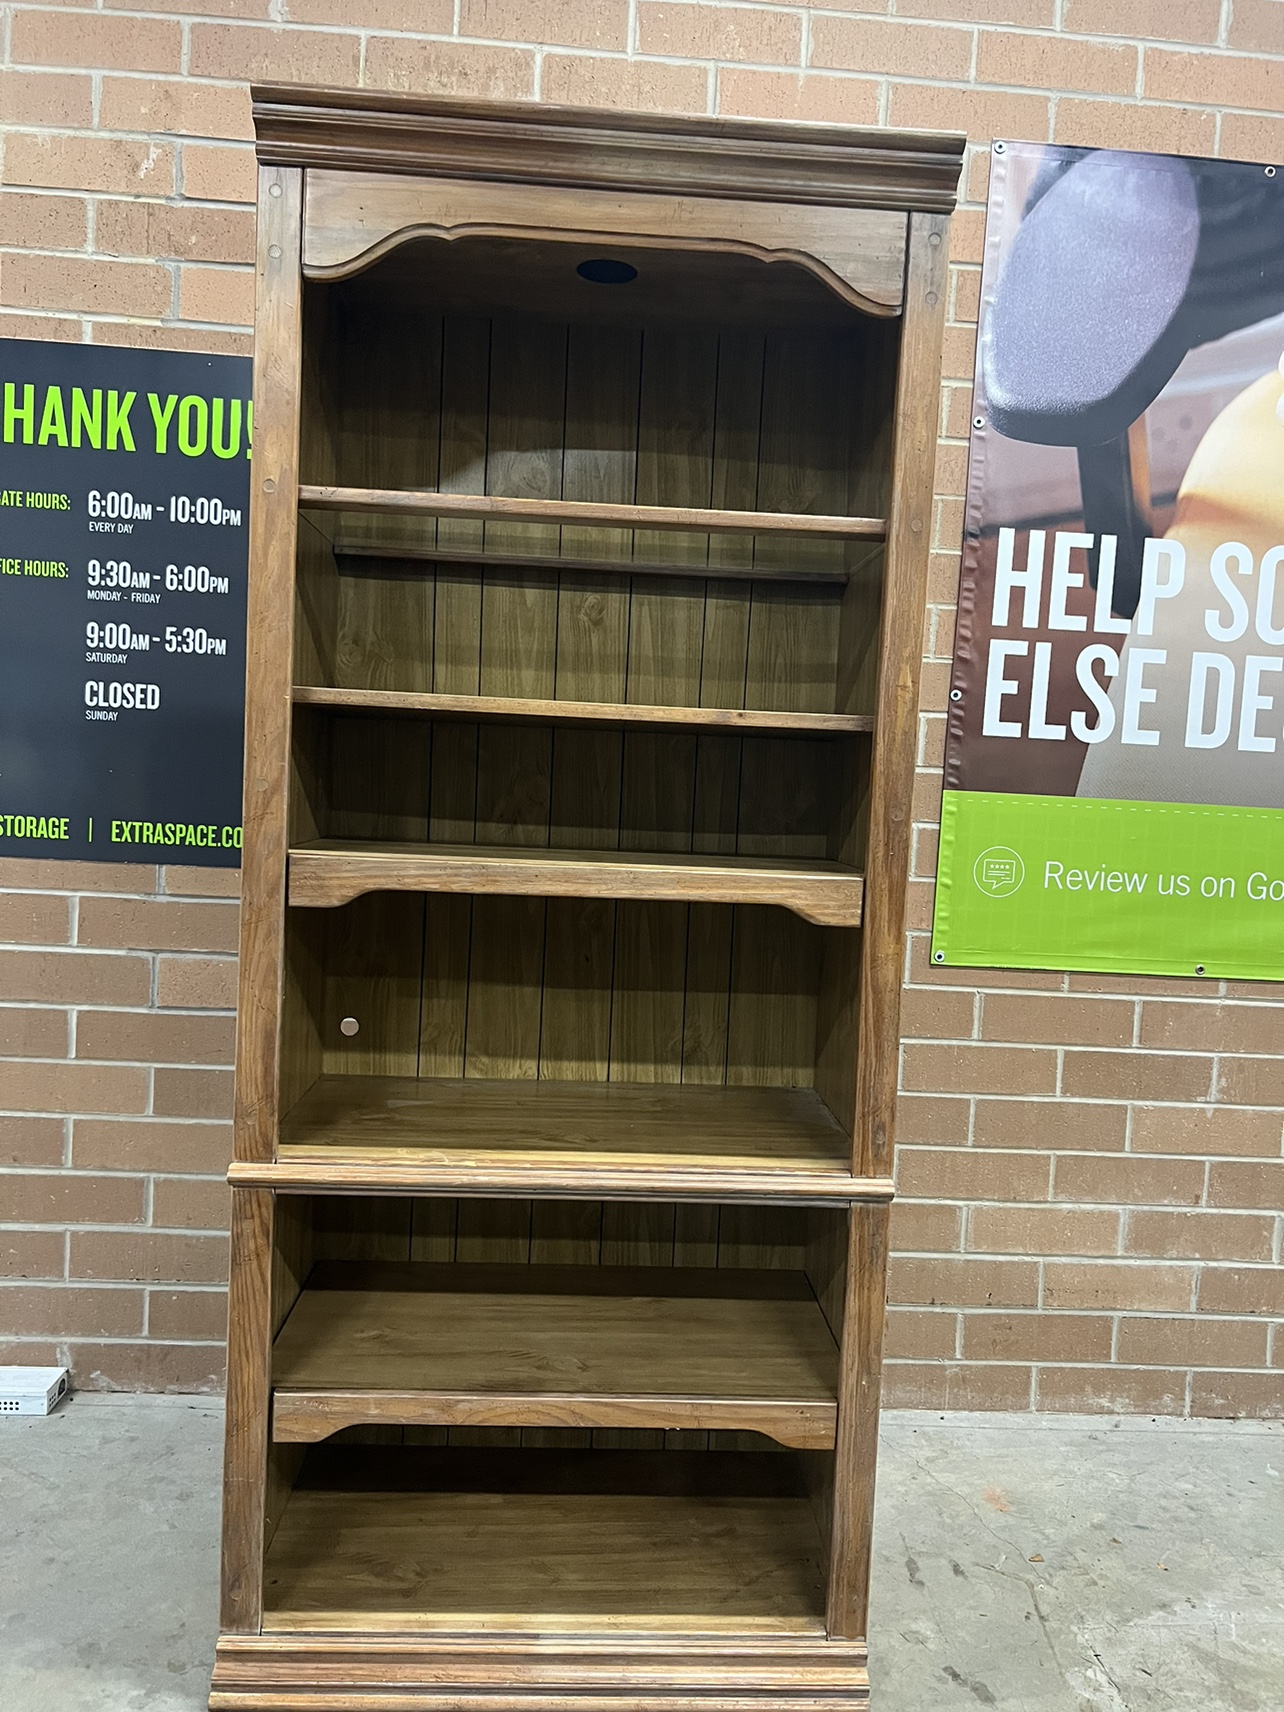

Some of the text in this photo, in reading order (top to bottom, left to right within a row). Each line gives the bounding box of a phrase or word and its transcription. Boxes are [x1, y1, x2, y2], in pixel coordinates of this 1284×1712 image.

[0, 490, 71, 511] ATE HOURS:
[87, 490, 152, 521] 6:00AM
[169, 496, 242, 527] 10:00PM
[89, 521, 134, 534] EVERY DAY
[0, 558, 69, 579] ICE HOURS:
[87, 559, 150, 589] 9:30AM
[165, 564, 229, 594] 6:00PM
[991, 527, 1186, 636] HELP
[87, 590, 121, 601] MONDAY
[131, 592, 161, 604] FRIDAY
[86, 621, 150, 651] 9:00AM
[165, 626, 227, 656] 5:30PM
[85, 652, 128, 664] SATURDAY
[84, 680, 161, 710] CLOSED
[982, 638, 1284, 753] ELSE DE
[85, 710, 118, 721] SUNDAY
[111, 820, 243, 849] EXTRASPACE.CO
[1043, 860, 1284, 901] Review us on Go
